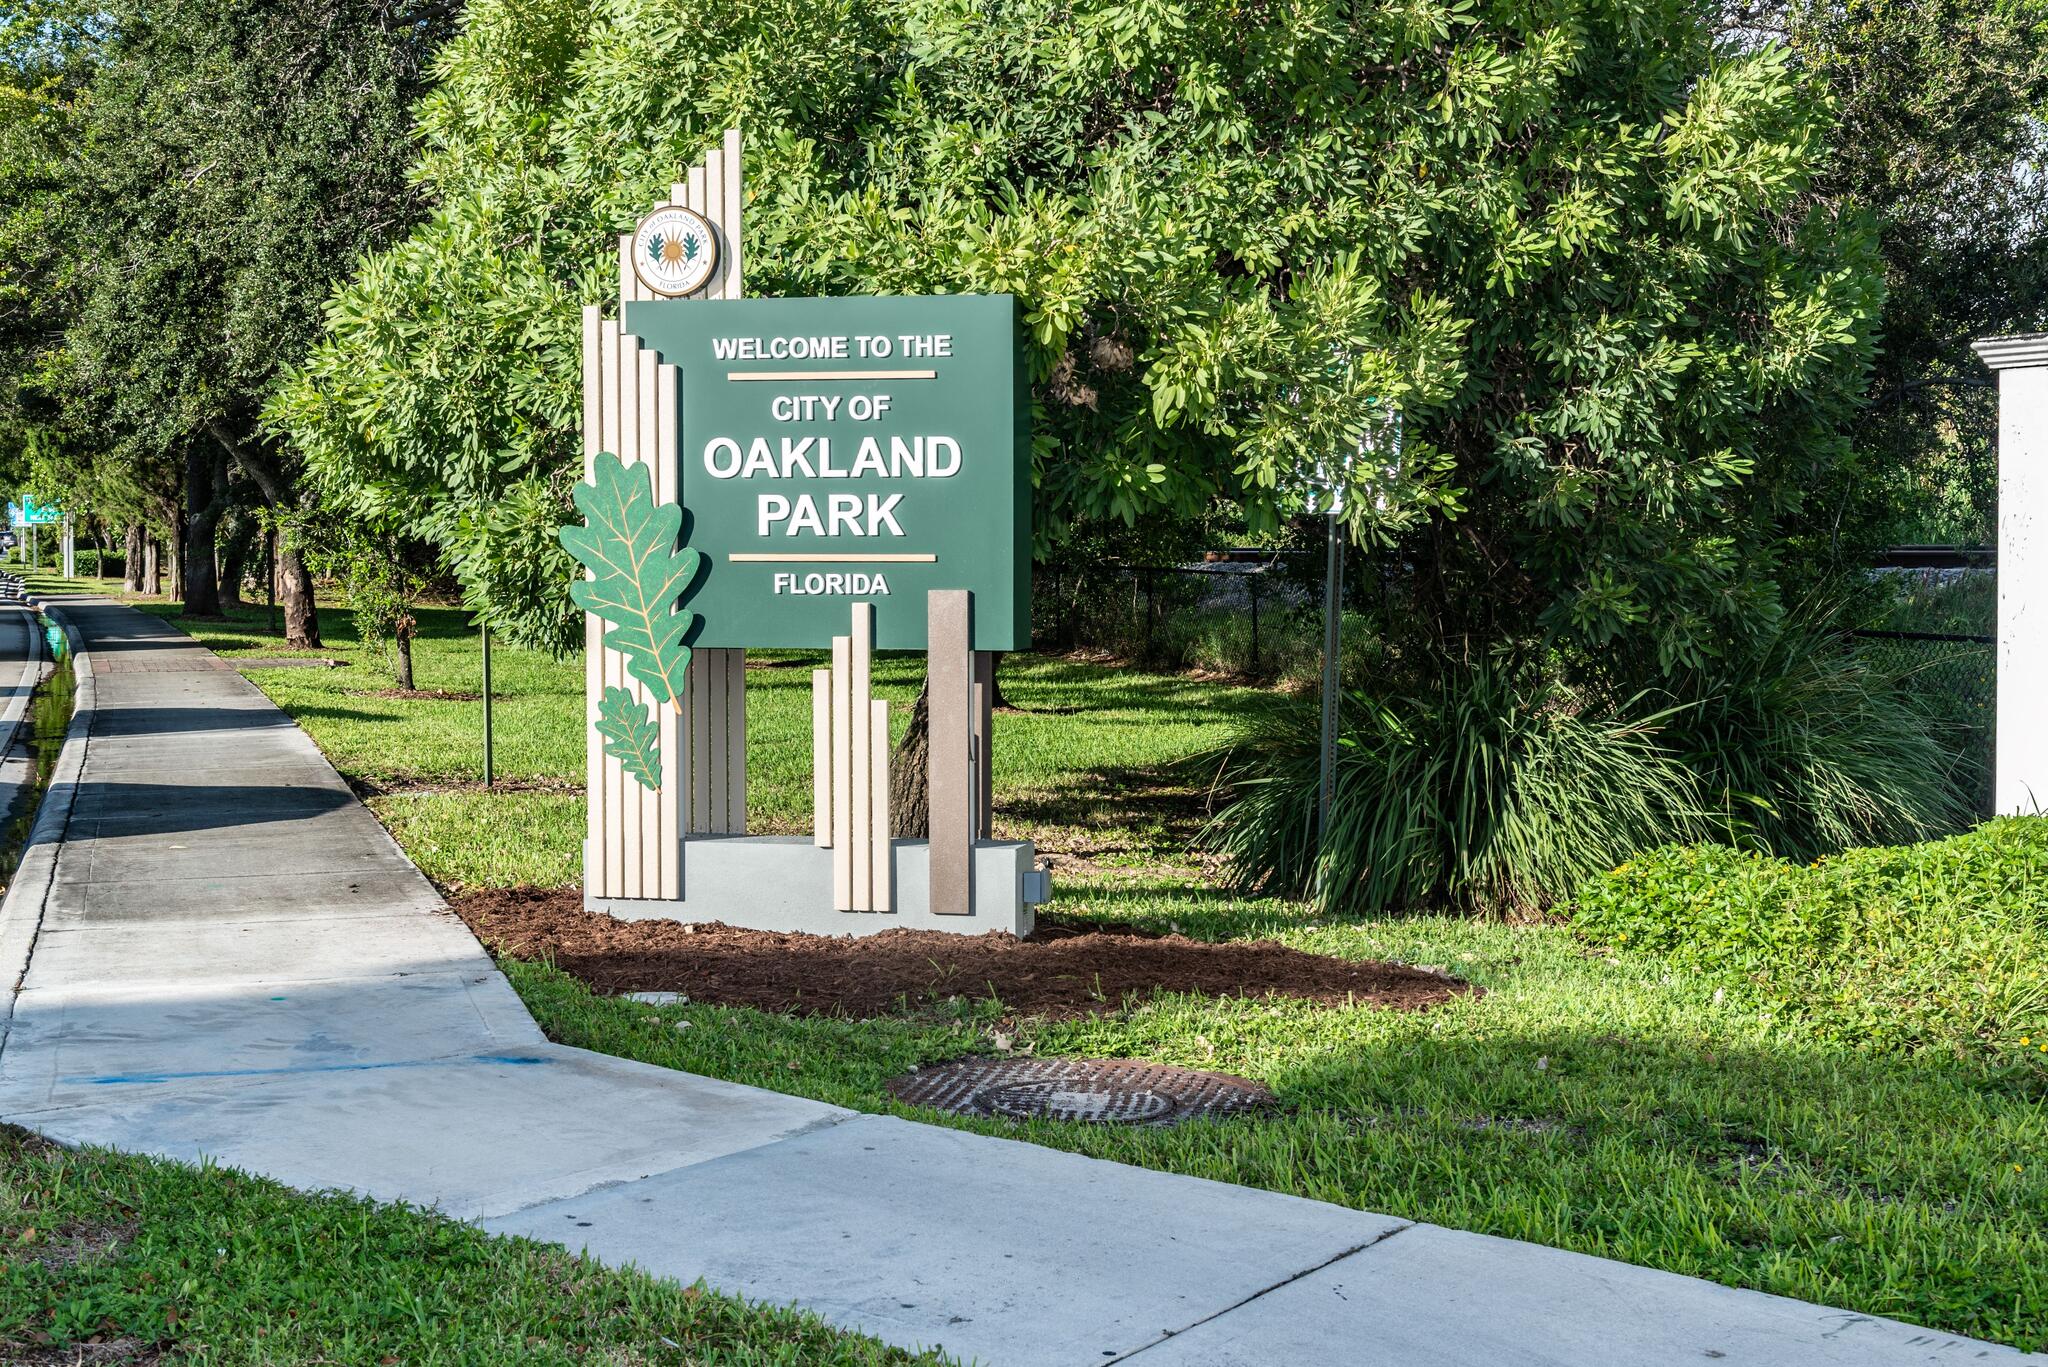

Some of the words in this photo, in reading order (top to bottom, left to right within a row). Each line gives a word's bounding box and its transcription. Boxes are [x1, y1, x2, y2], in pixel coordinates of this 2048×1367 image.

[638, 229, 649, 247] CITY
[656, 213, 695, 225] OAKLAND
[695, 224, 708, 244] PARK
[659, 280, 690, 290] FLORIDA
[712, 336, 849, 359] WELCOME
[855, 335, 892, 358] TO
[898, 334, 952, 358] THE
[771, 396, 842, 421] CITY
[848, 395, 891, 420] OF
[703, 436, 963, 479] OAKLAND
[758, 494, 906, 536] PARK
[774, 573, 890, 595] FLORIDA
